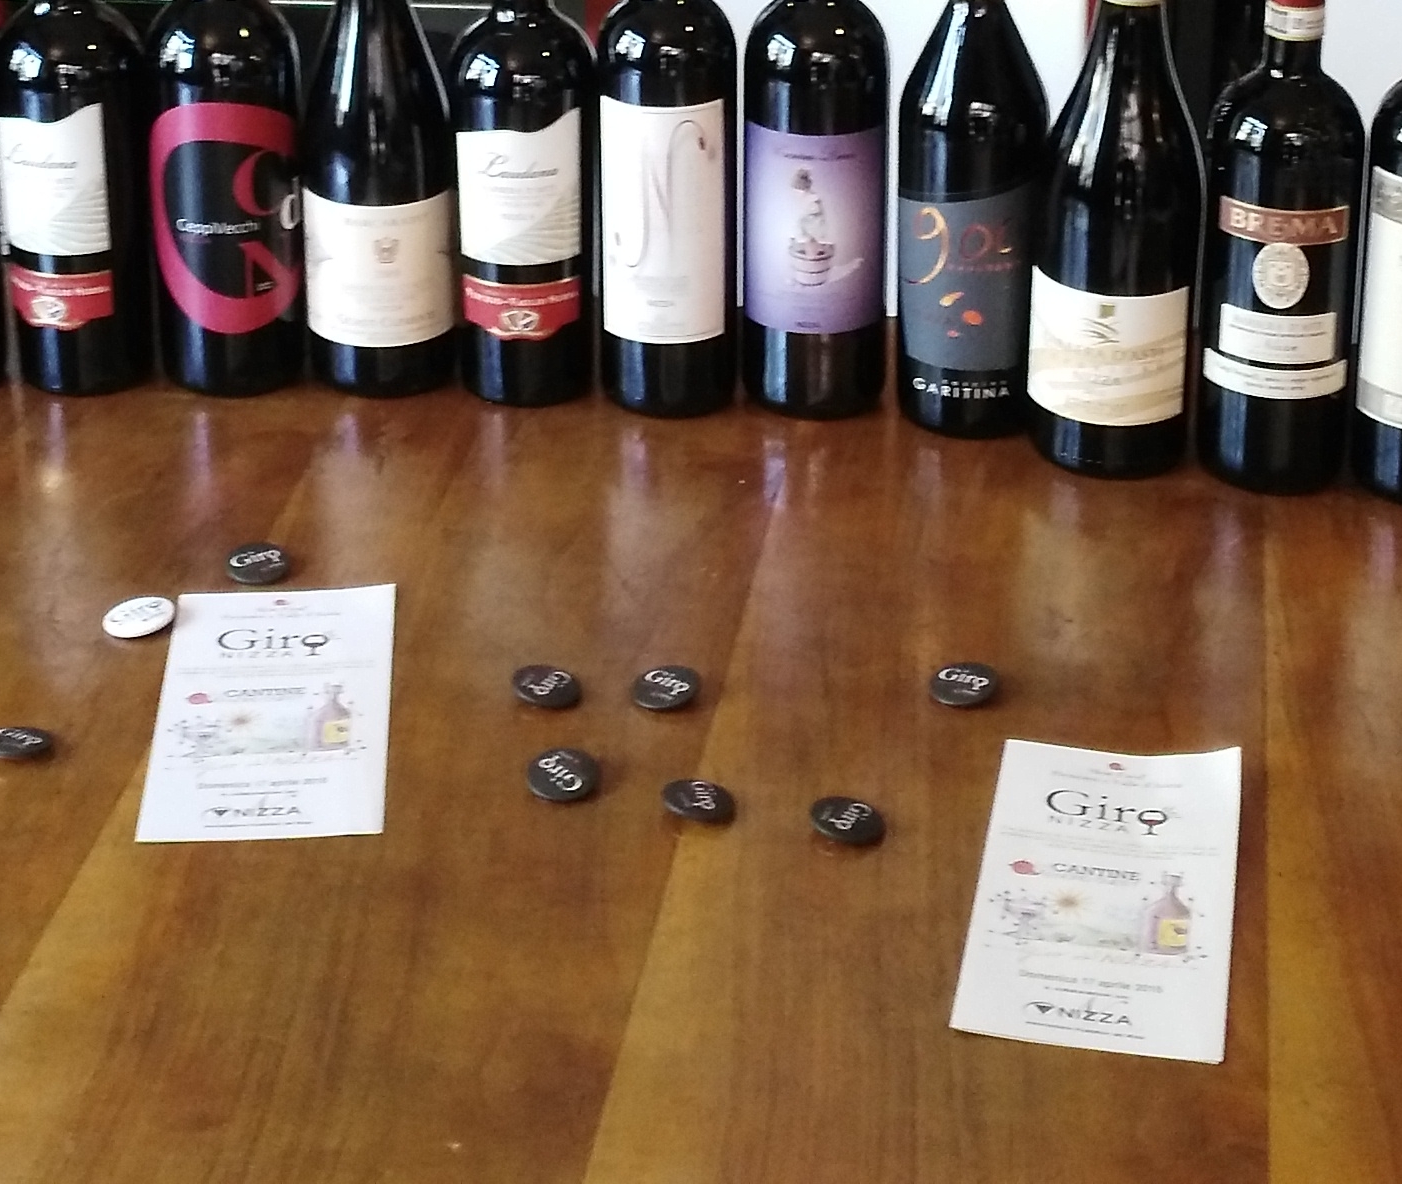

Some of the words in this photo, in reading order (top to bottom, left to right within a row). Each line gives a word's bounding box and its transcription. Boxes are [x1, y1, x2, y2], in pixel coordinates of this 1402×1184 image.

[1230, 208, 1338, 237] BREMA
[912, 377, 1010, 399] GARITINA
[230, 550, 281, 568] Giro
[216, 627, 331, 657] Giro
[644, 669, 690, 695] Giro
[939, 667, 990, 692] Giro
[1045, 789, 1169, 836] Giro
[1049, 816, 1131, 834] NIZZA
[1051, 863, 1142, 882] CANTINE
[1057, 1007, 1134, 1026] NIZZA
